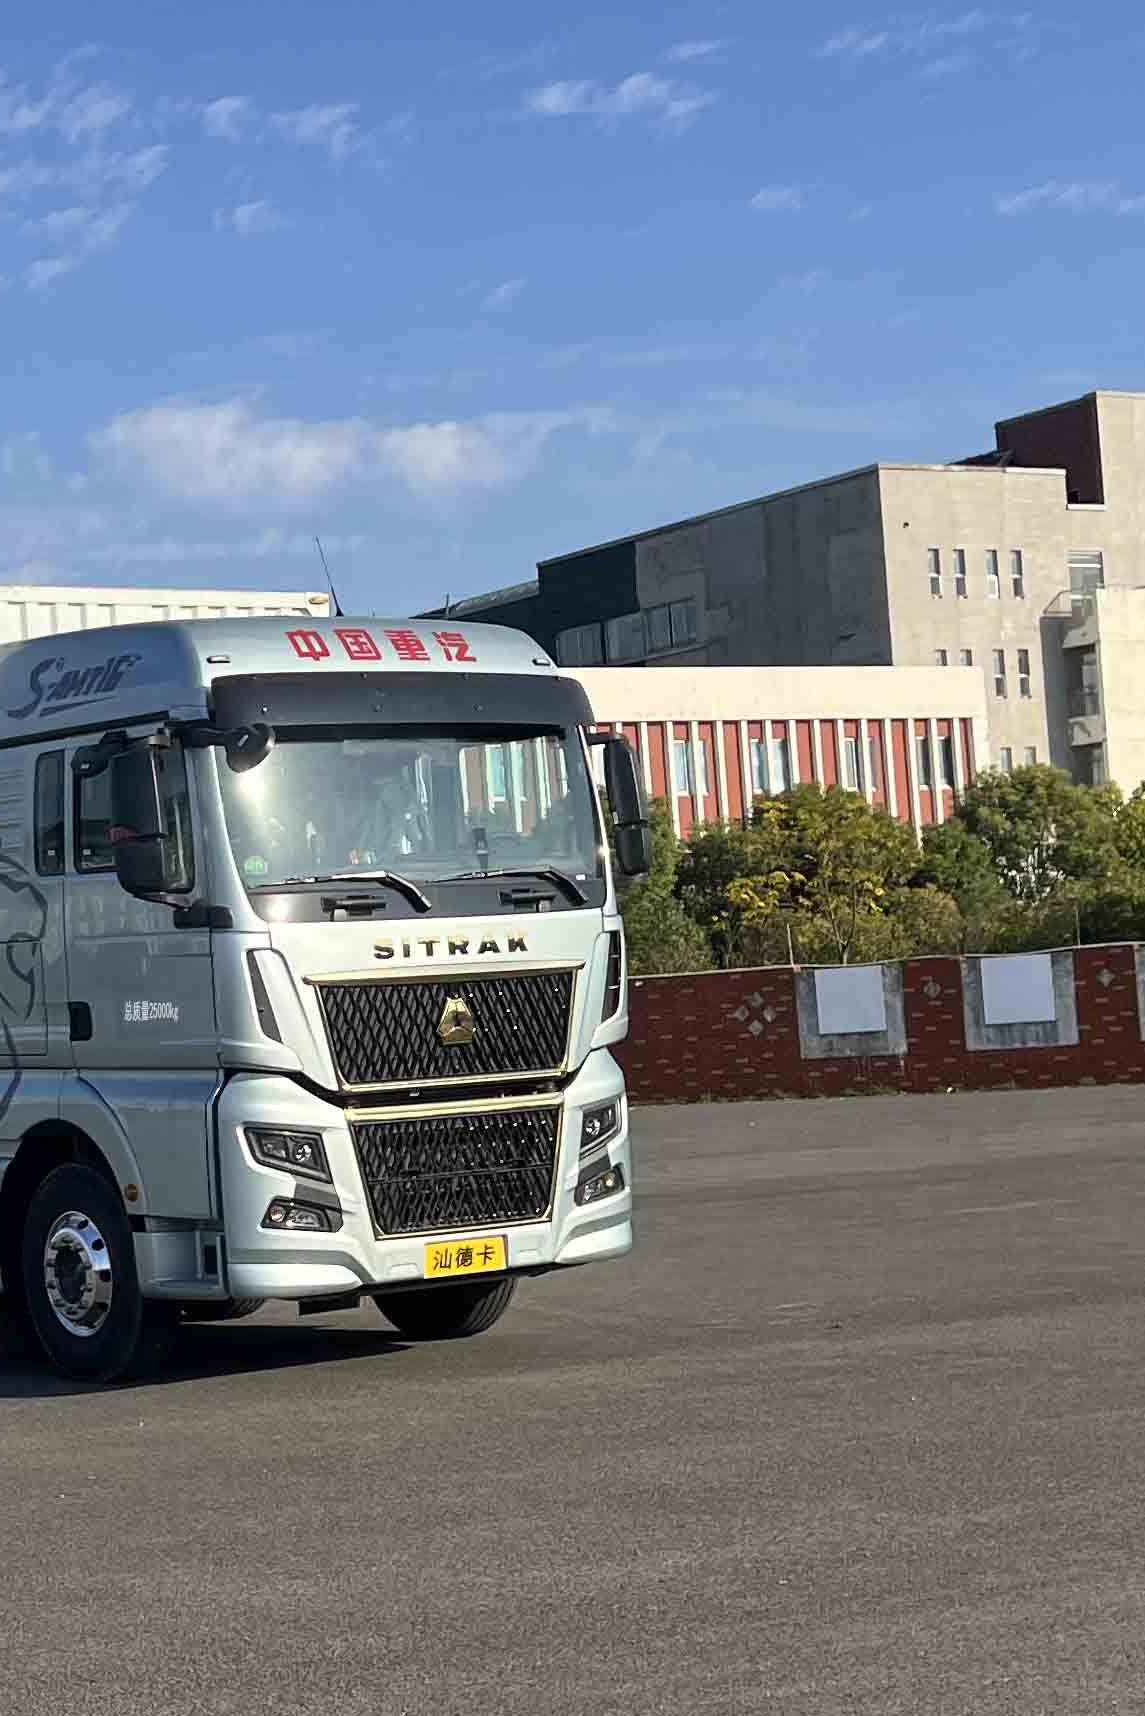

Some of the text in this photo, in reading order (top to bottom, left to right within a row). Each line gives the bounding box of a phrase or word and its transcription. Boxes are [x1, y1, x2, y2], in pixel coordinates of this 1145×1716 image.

[285, 628, 477, 662] 中国重汽
[373, 933, 529, 960] SITRAK
[433, 1243, 496, 1270] 汕德卡
